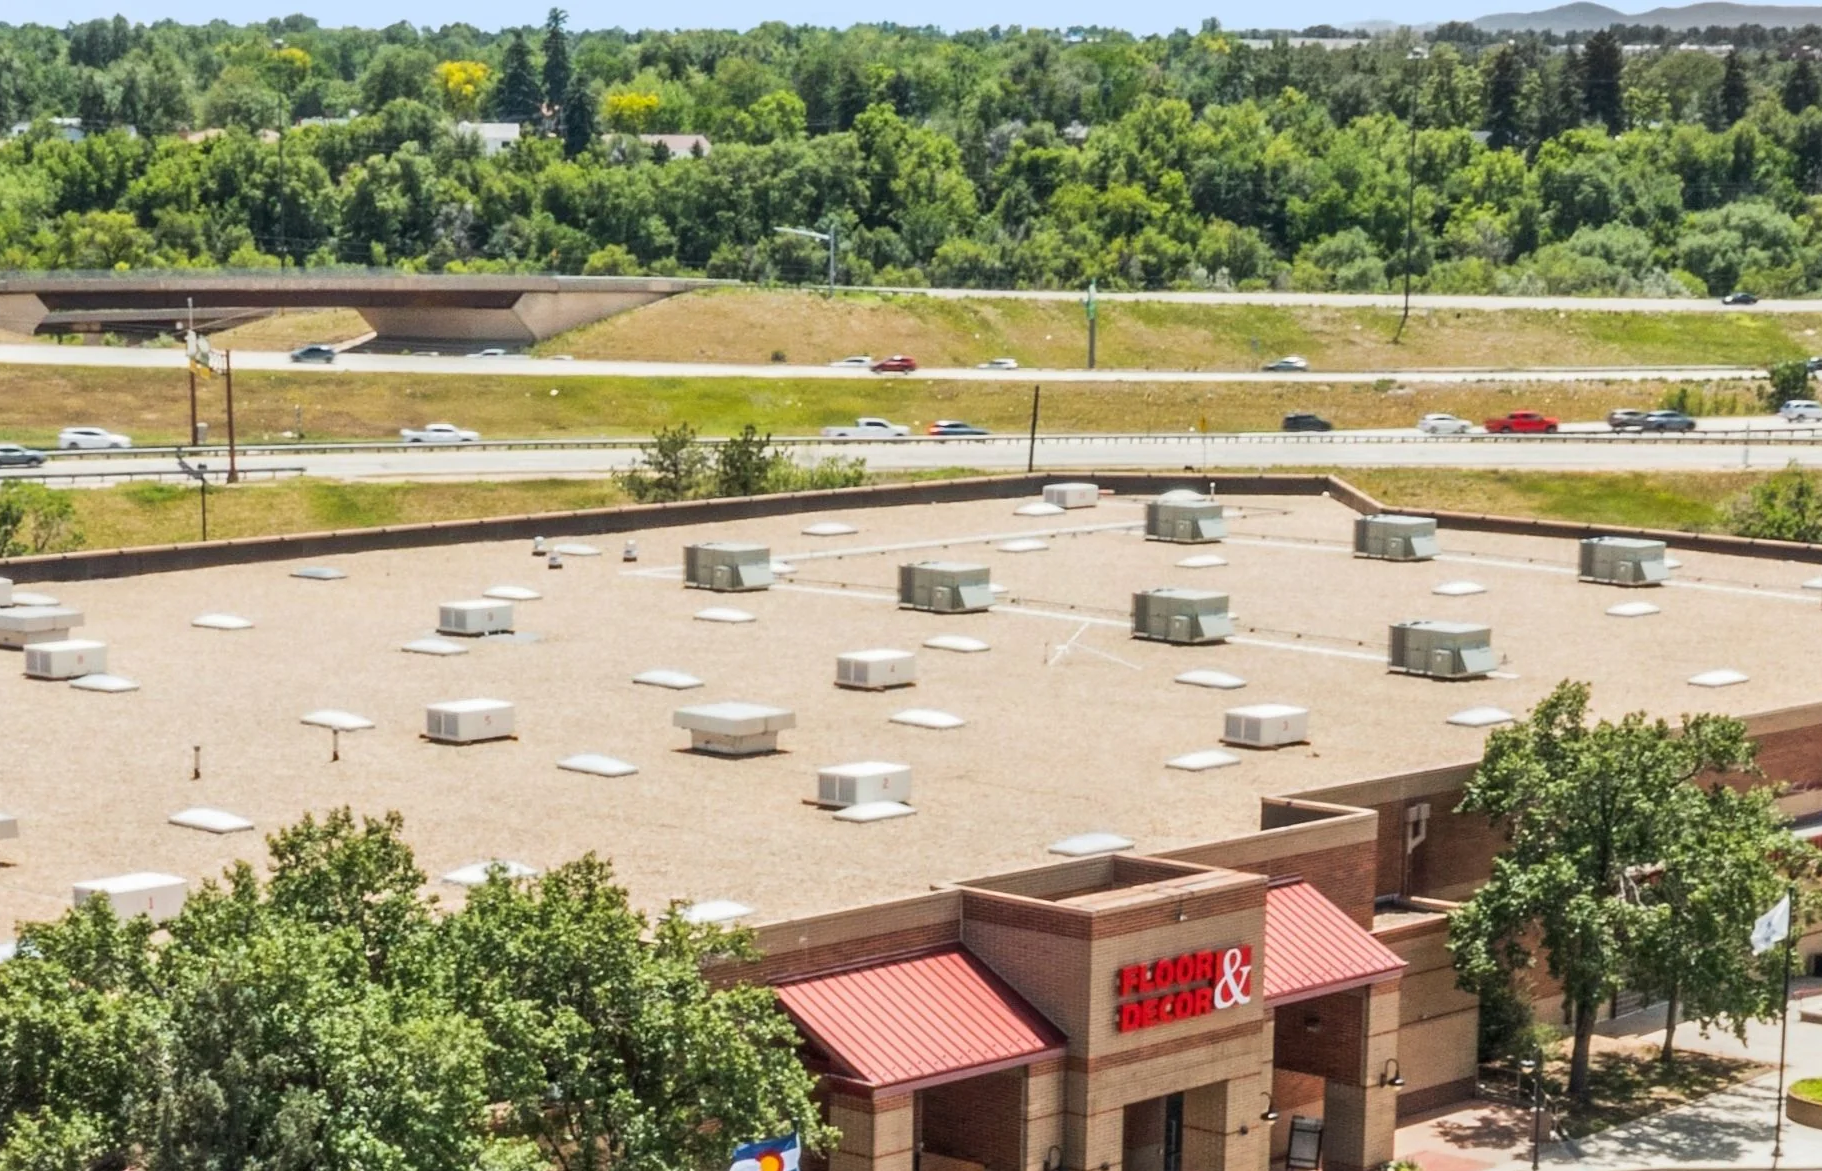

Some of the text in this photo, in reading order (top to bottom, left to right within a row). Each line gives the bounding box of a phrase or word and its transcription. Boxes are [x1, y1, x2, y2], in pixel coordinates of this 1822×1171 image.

[1117, 948, 1252, 1010] FLOOR &
[1117, 987, 1214, 1036] DECOR
